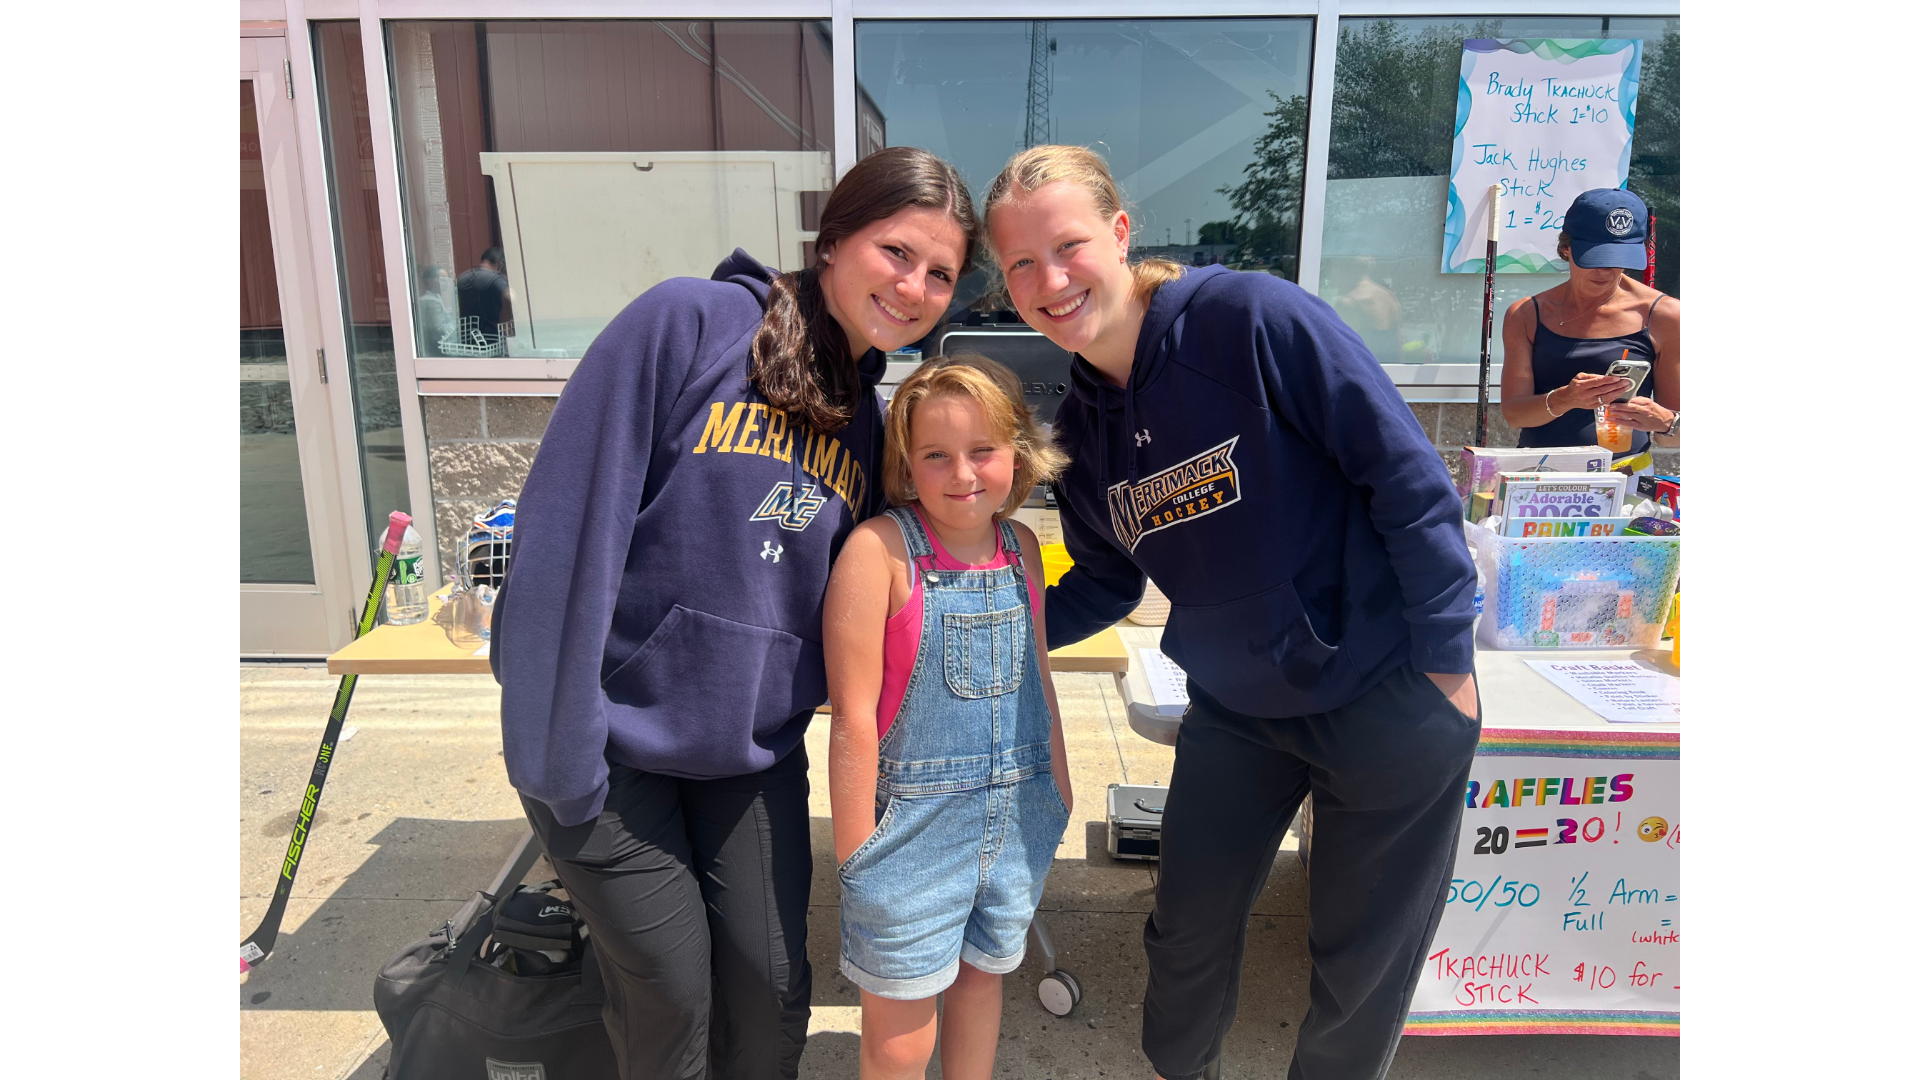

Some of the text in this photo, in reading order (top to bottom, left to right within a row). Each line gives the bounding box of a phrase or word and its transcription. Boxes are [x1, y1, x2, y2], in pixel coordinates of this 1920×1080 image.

[1487, 71, 1533, 98] Brady
[1510, 102, 1559, 124] Stick
[1472, 143, 1587, 185] Jack Hughes
[1500, 178, 1553, 198] Stick
[1597, 406, 1605, 423] CED
[1108, 446, 1230, 550] MERRIMACK
[1173, 482, 1215, 505] COLLEGE
[1528, 493, 1595, 504] Adorable
[1152, 490, 1224, 527] HOCKEY
[1518, 504, 1602, 518] DOGS
[1522, 521, 1615, 538] PAINT BY
[1464, 773, 1635, 809] RAFFLES
[282, 783, 320, 881] FISCHER
[1447, 875, 1540, 912] 50/50
[1608, 878, 1659, 905] Arm
[1563, 911, 1605, 932] Full
[1428, 948, 1551, 981] TKACHUCK
[1574, 960, 1664, 990] $10 for
[1455, 981, 1539, 1007] STICK
